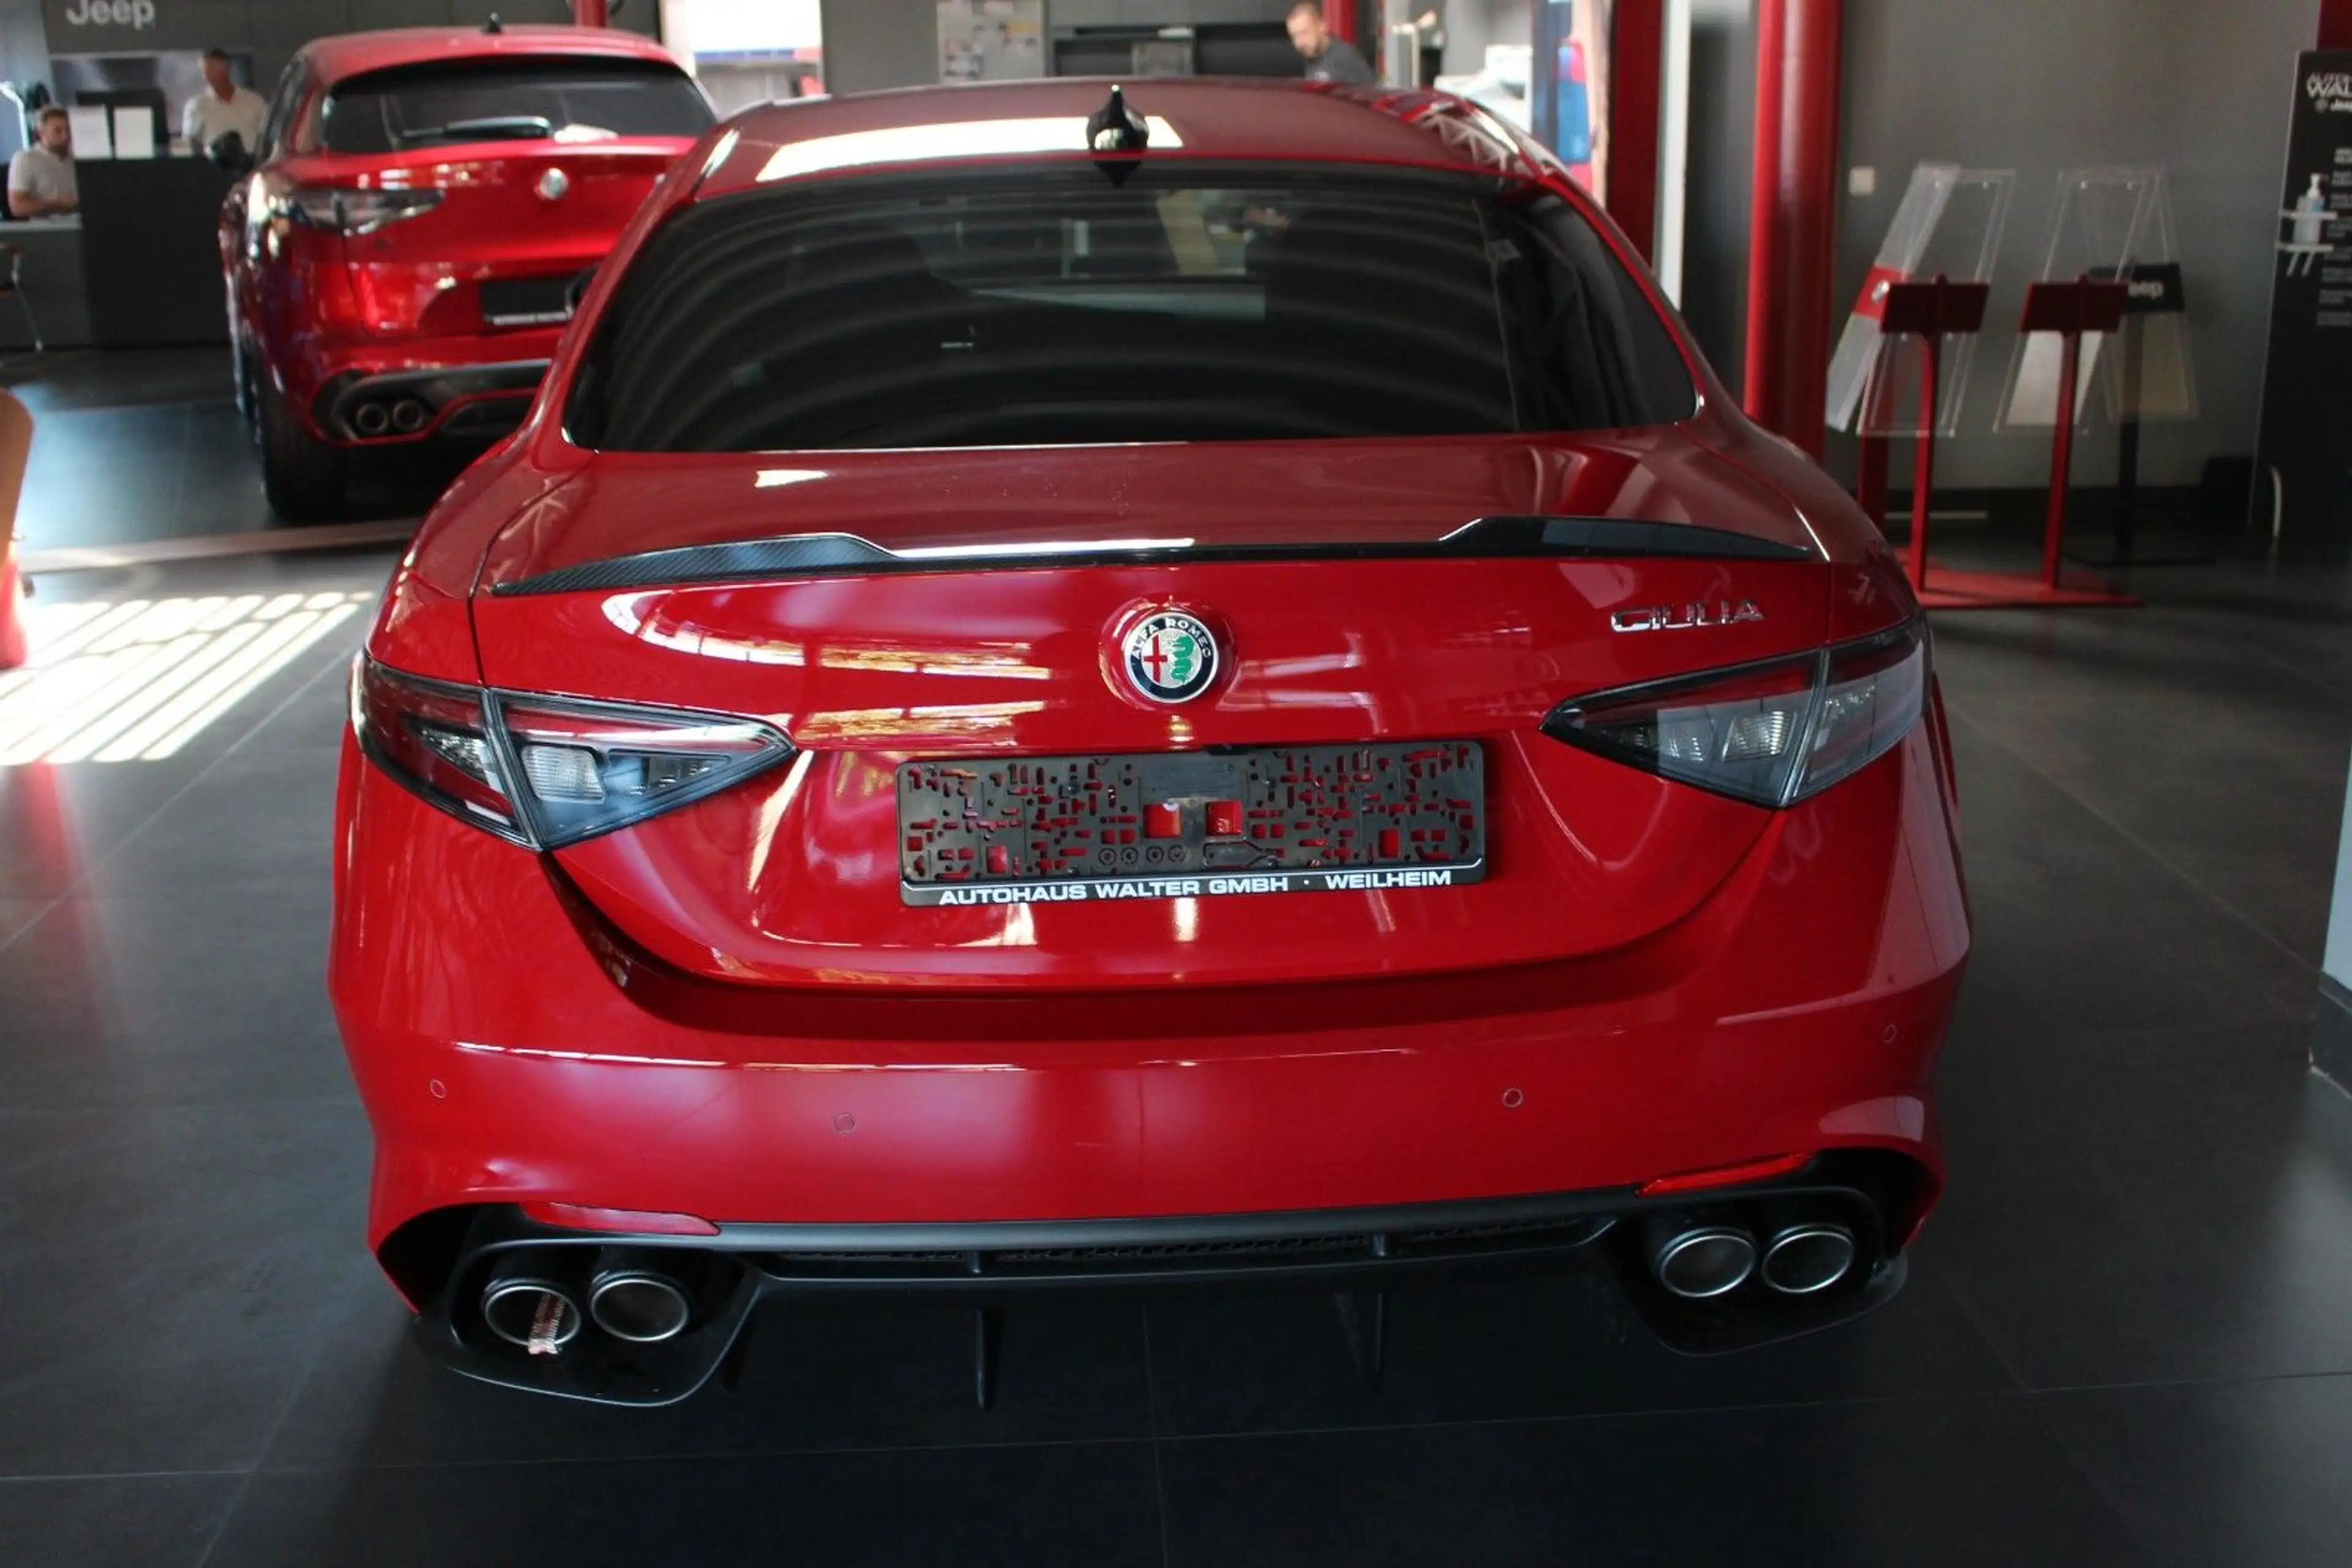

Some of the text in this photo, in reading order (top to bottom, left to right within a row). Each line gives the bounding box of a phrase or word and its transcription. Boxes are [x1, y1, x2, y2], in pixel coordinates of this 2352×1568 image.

[65, 0, 156, 29] Jeep
[1611, 599, 1765, 633] GIULIA
[1132, 617, 1212, 659] ALFA ROMEO
[939, 870, 1452, 906] AUTOHAUS WALTER GMBH WEILHEIM
